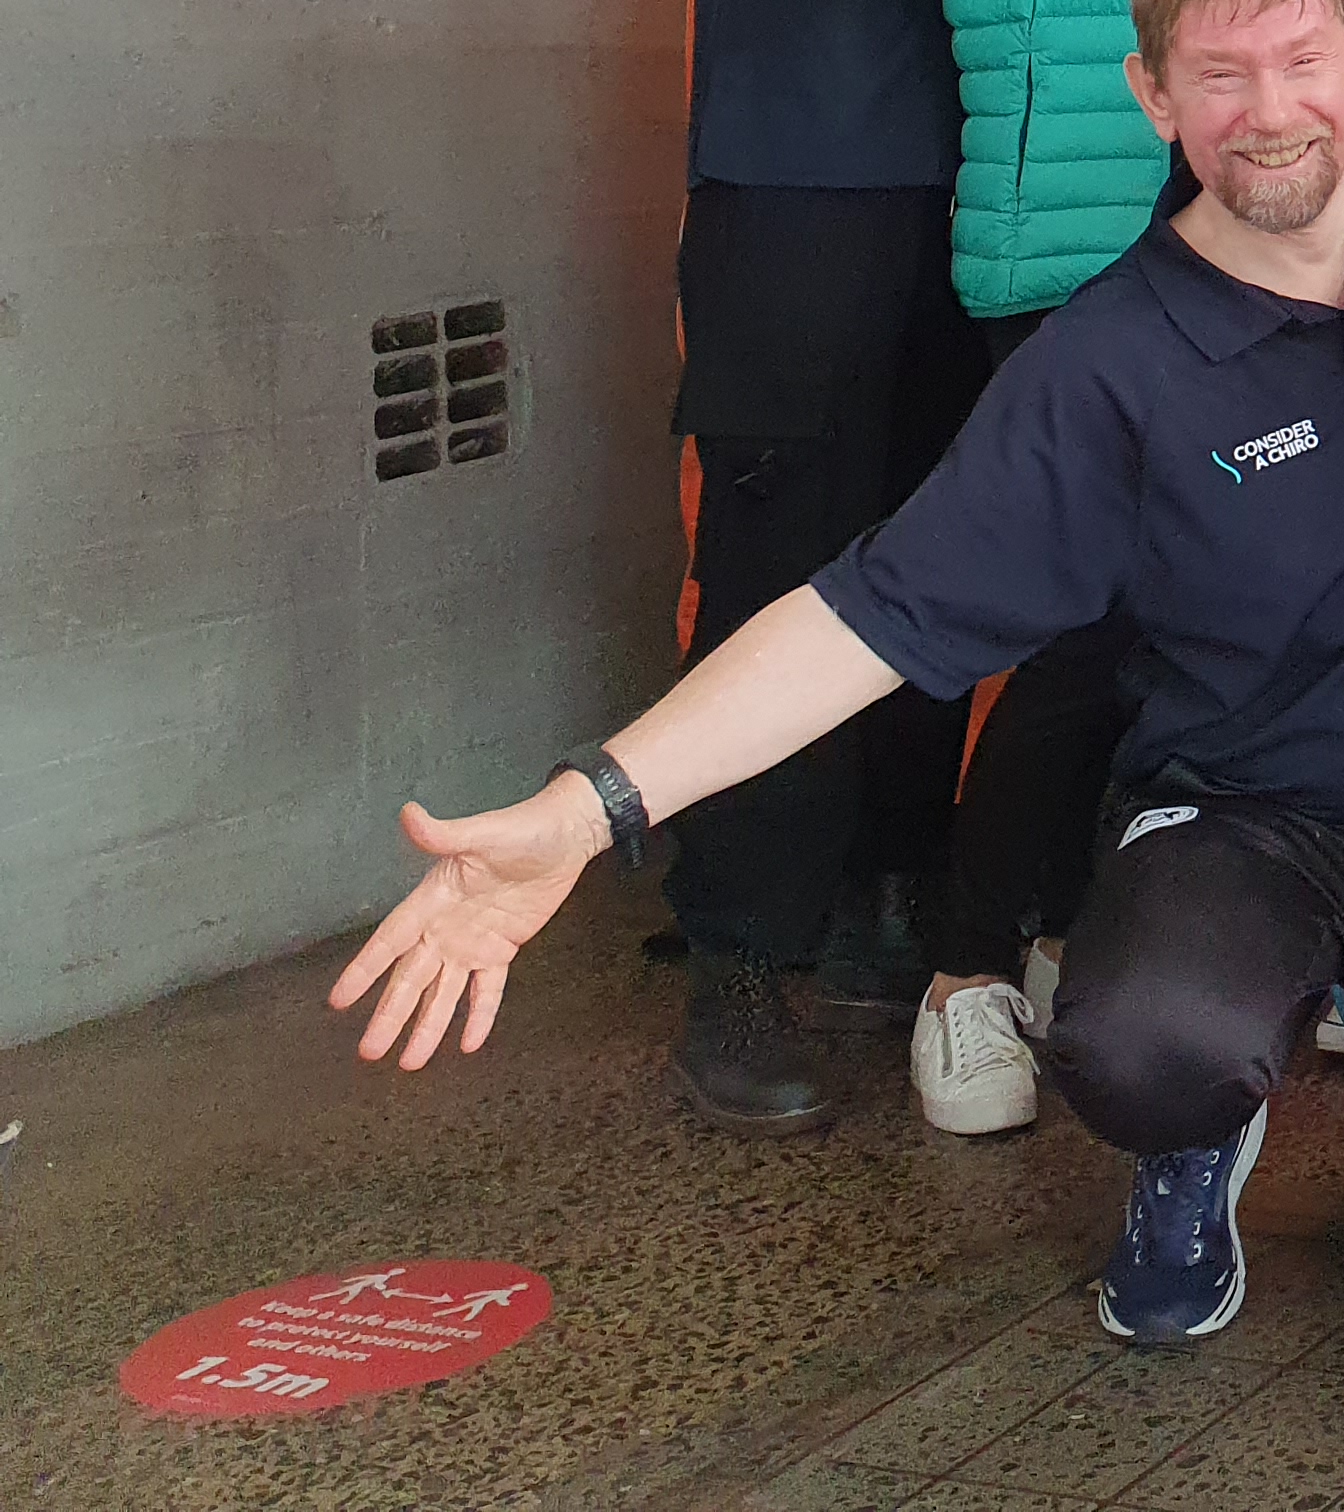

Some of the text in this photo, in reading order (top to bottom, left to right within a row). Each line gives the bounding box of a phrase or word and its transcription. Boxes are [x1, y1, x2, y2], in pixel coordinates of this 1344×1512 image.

[1233, 419, 1316, 462] CONSIDER
[1256, 433, 1319, 471] A CHIRO
[175, 1356, 330, 1399] 1.5m
